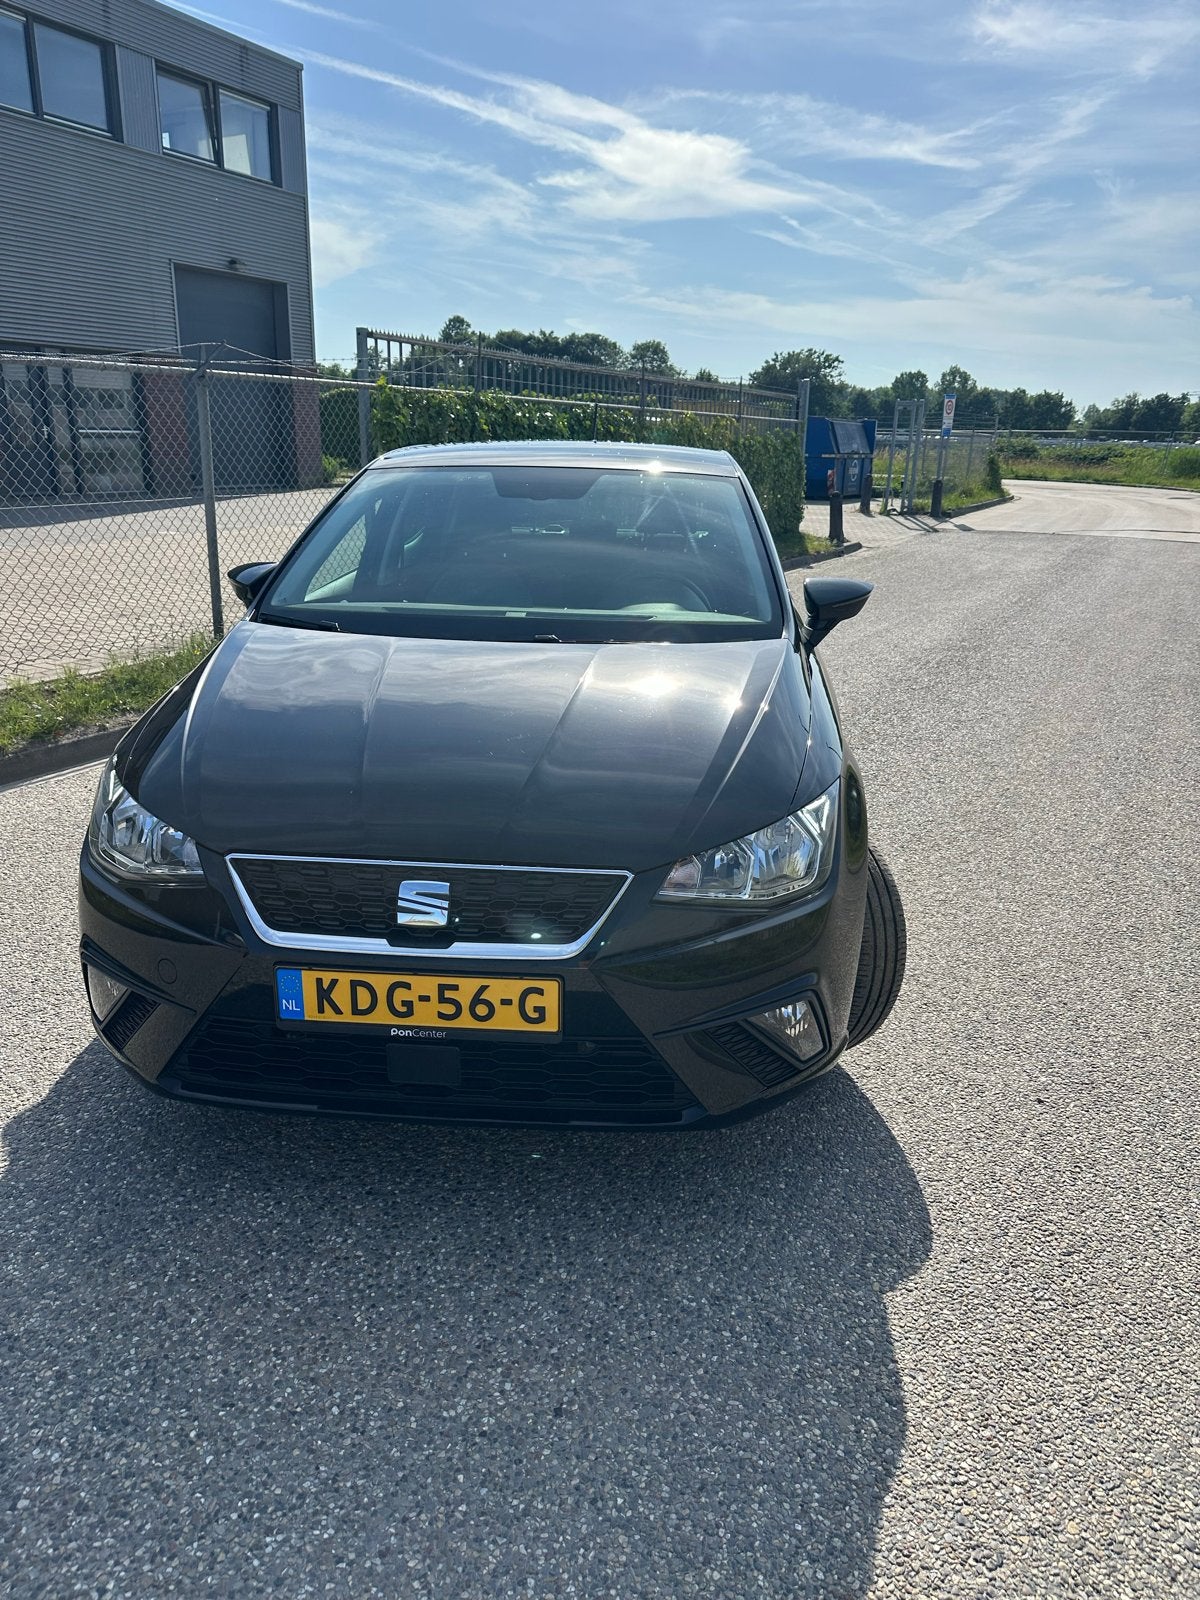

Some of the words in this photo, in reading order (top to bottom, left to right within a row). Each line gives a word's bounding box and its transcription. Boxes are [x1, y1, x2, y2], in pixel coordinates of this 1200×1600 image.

[282, 999, 301, 1011] NL
[315, 977, 546, 1025] KDG-56-G
[390, 1027, 447, 1038] PonCenter
